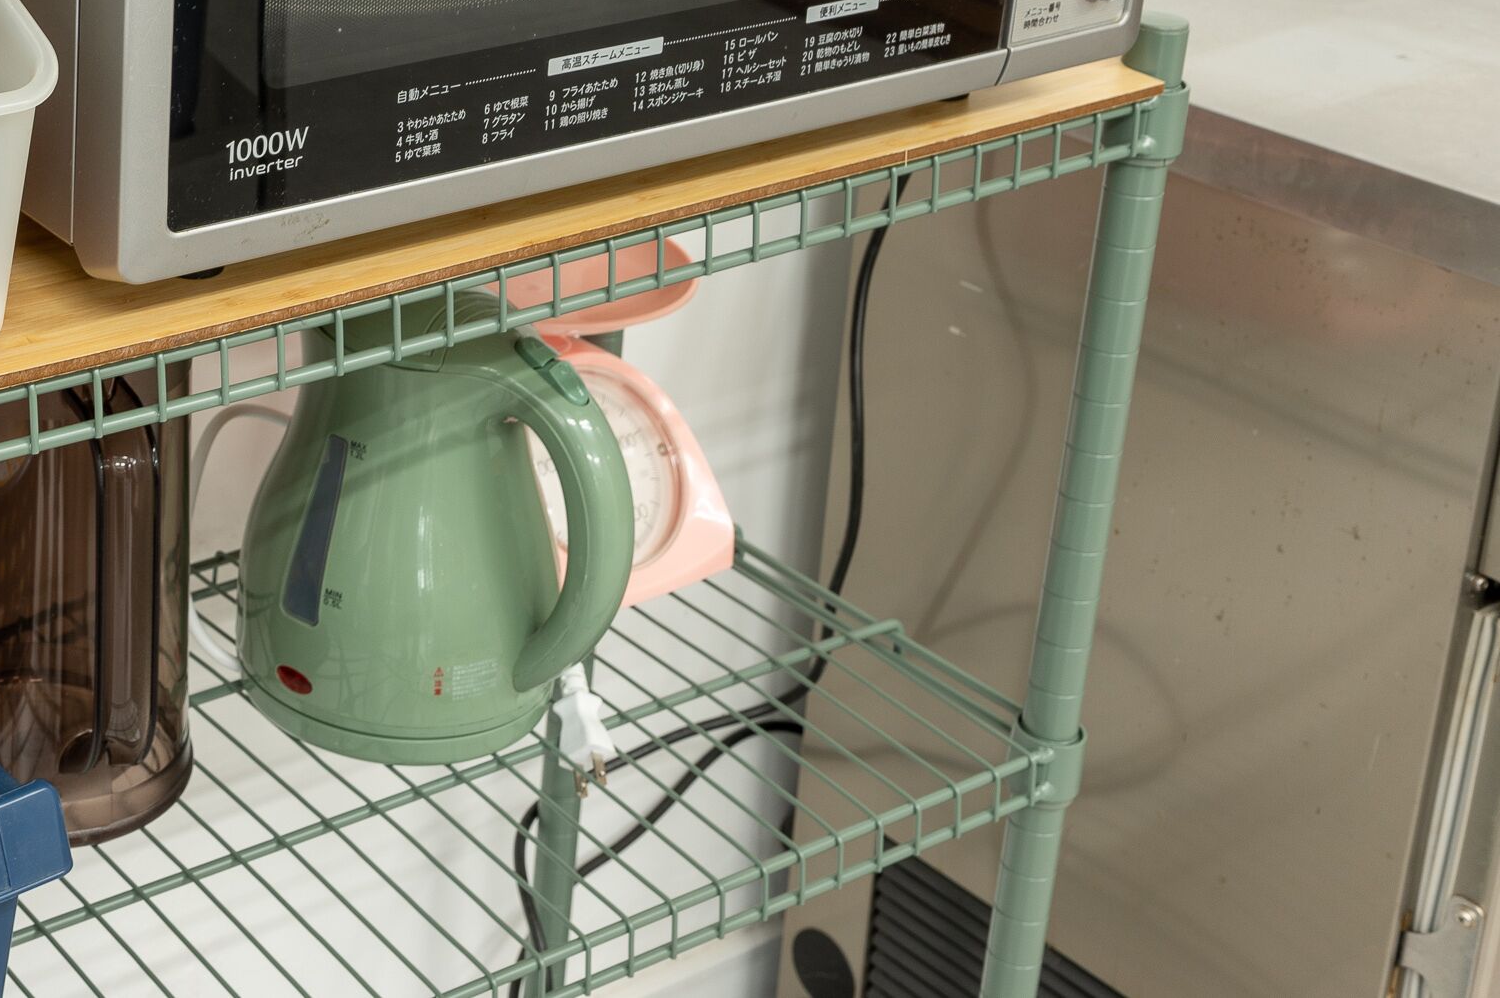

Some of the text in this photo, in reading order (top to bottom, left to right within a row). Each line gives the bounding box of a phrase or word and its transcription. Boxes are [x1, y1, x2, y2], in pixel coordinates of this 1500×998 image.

[819, 2, 867, 19] 便利メニュー
[1024, 2, 1061, 18] メニュー番号
[1023, 14, 1059, 30] 時間合わせ
[725, 31, 779, 51] 15 ロールパン
[804, 26, 863, 48] 19 豆腐の水切り
[886, 33, 897, 44] 22
[561, 46, 650, 71] 高温スチームメニュー
[723, 53, 734, 65] 16
[802, 41, 861, 62] 20 乾物のもどし
[884, 47, 895, 58] 23
[635, 71, 647, 83] 12
[722, 56, 787, 79] 17 ヘルシーセット
[800, 65, 811, 76] 21
[397, 84, 461, 104] 自動メニュー
[549, 78, 619, 101] 9 フライあたため
[634, 77, 690, 98] 13 茶わん蒸し
[720, 81, 731, 93] 18
[484, 95, 529, 115] 6 ゆで根菜
[545, 95, 596, 117] 10 から揚げ
[632, 87, 704, 112] 14 スポンジケーキ
[397, 109, 466, 133] 3 やわらかあたため
[483, 112, 526, 129] 7 グラタン
[544, 107, 609, 131] 11 鶏の照り焼き
[226, 126, 309, 165] 1000W
[396, 136, 403, 148] 4
[482, 127, 515, 144] 8 フライ
[395, 143, 441, 163] 5 ゆで葉菜
[229, 155, 303, 181] inverter
[350, 440, 367, 451] MAX
[325, 588, 343, 599] MIN
